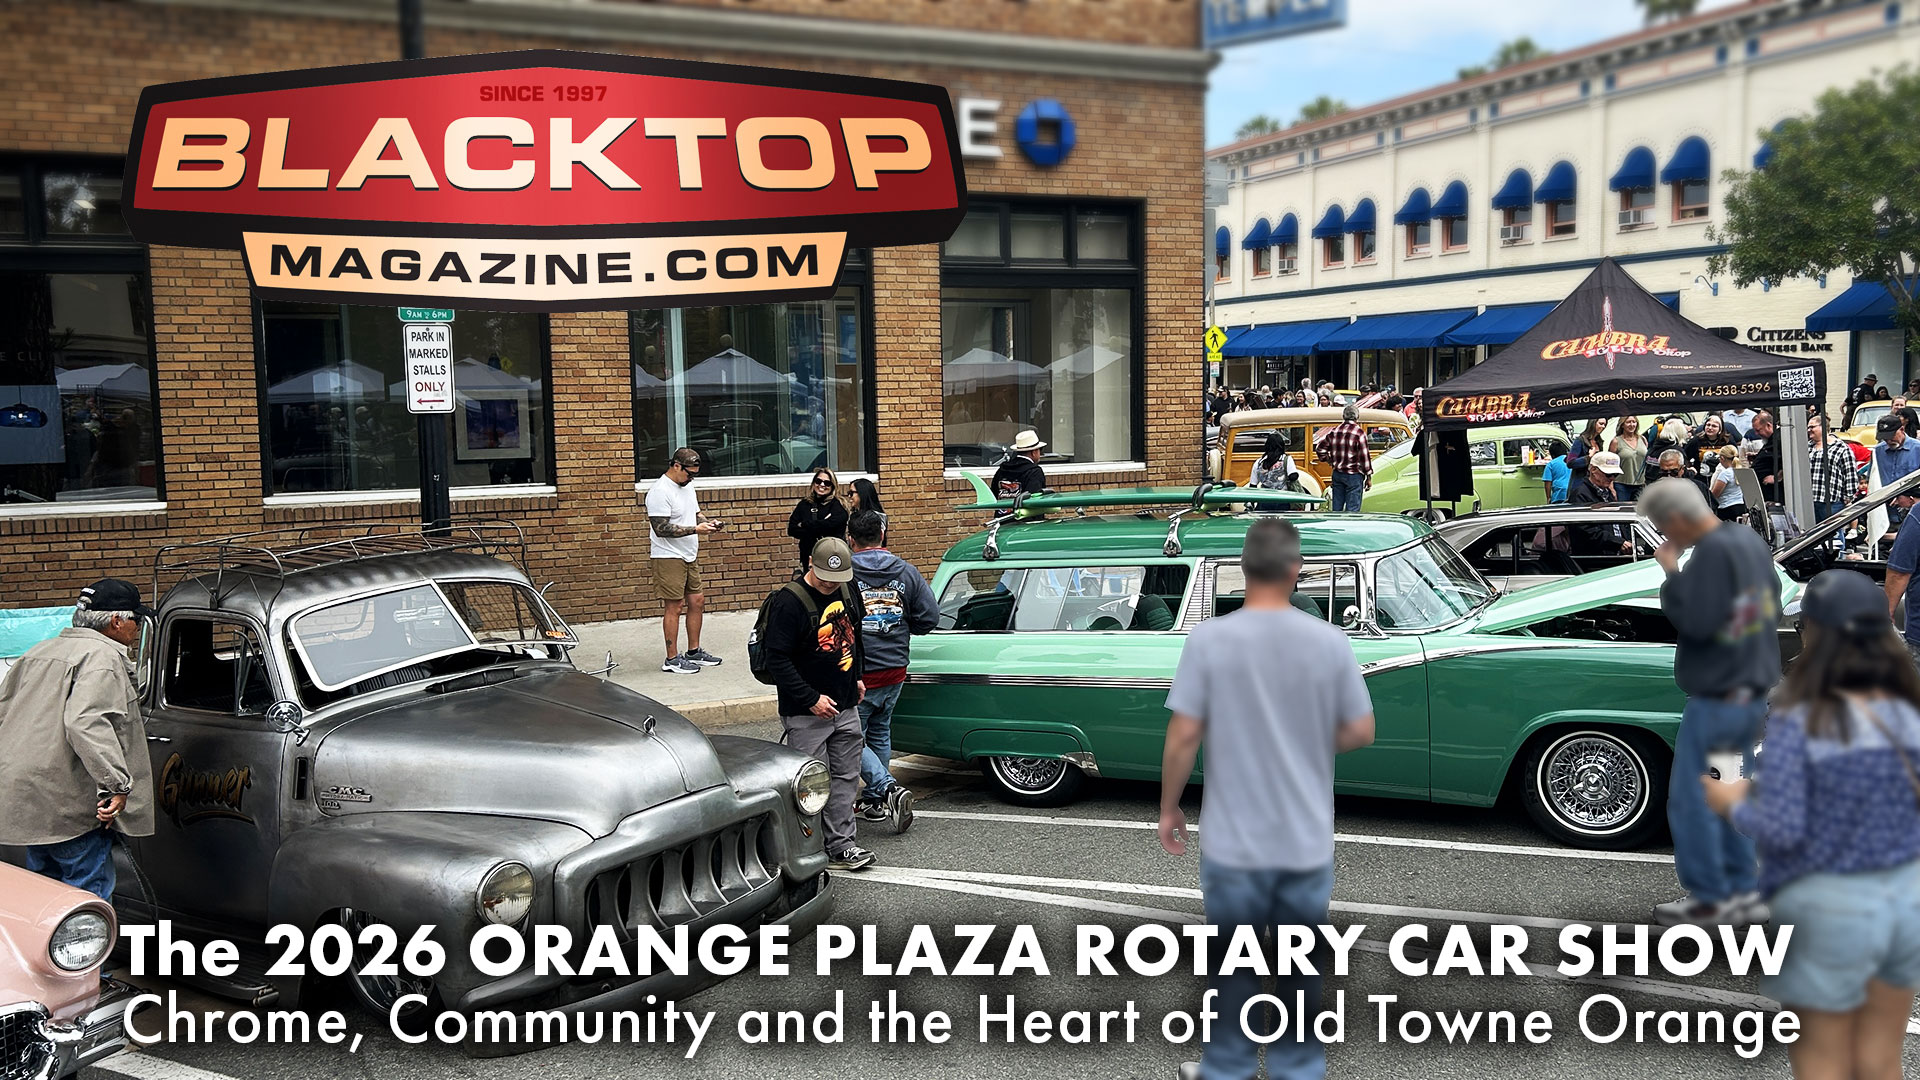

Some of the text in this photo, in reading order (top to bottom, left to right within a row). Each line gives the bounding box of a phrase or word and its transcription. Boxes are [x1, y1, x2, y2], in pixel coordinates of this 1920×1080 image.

[406, 310, 423, 318] 9AM
[432, 310, 448, 318] 6PM
[411, 331, 445, 342] PARK IN
[1747, 327, 1827, 341] CITIZENS
[1541, 331, 1671, 360] CAMBRA
[1743, 343, 1833, 352] SINESS BANK
[409, 348, 448, 359] MARKED
[413, 365, 446, 376] STALLS
[415, 381, 445, 392] ONLY
[1548, 382, 1771, 408] CambraSpeedShop.com 714-538-5396
[1436, 392, 1531, 418] CAMBRA
[160, 752, 252, 815] Gunner
